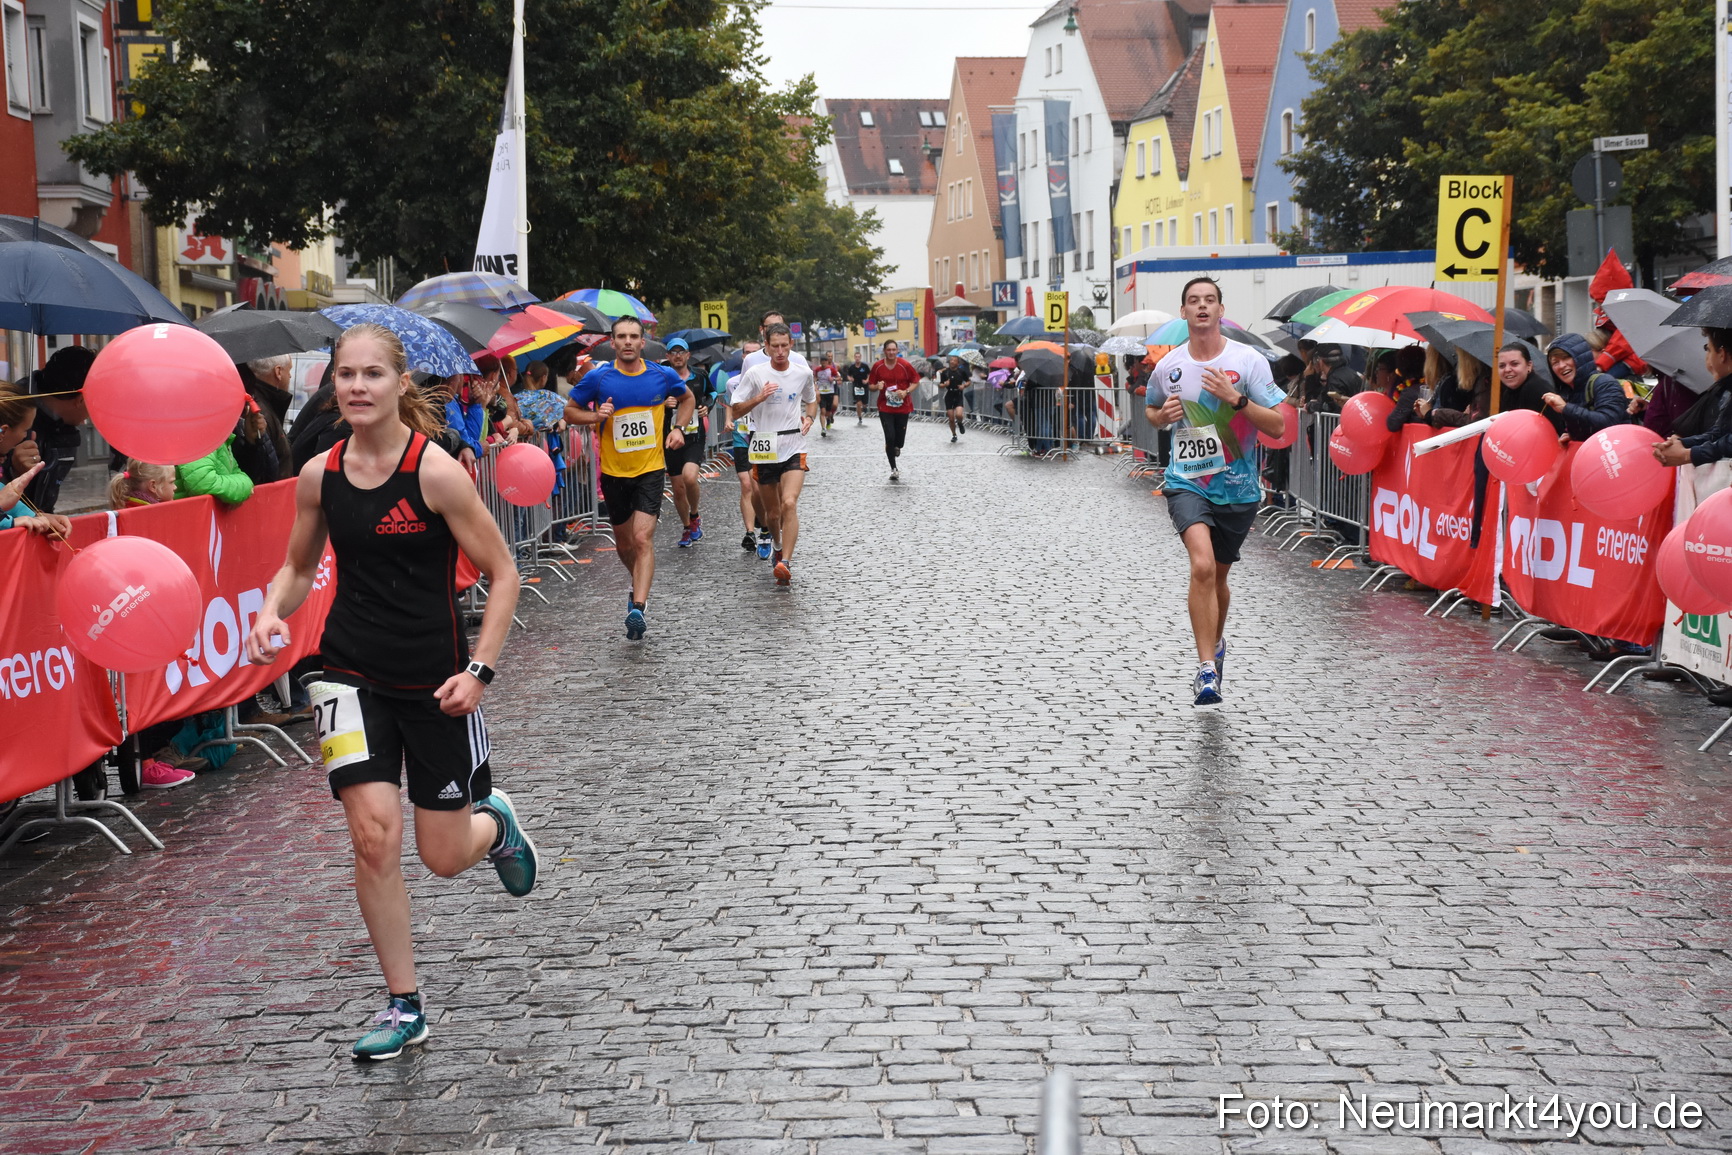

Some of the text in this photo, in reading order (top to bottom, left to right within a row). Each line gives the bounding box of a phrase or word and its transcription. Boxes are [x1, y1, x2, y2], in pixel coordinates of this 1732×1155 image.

[1448, 180, 1504, 199] Block
[1454, 207, 1492, 259] C
[1047, 293, 1067, 301] Block
[703, 303, 725, 311] Block
[1050, 304, 1063, 323] D
[708, 313, 722, 330] D
[621, 421, 648, 438] 286
[752, 439, 771, 452] 263
[1178, 437, 1218, 459] 2369
[1183, 460, 1214, 472] Bernhard
[375, 520, 427, 535] adidas
[438, 791, 463, 799] adidas
